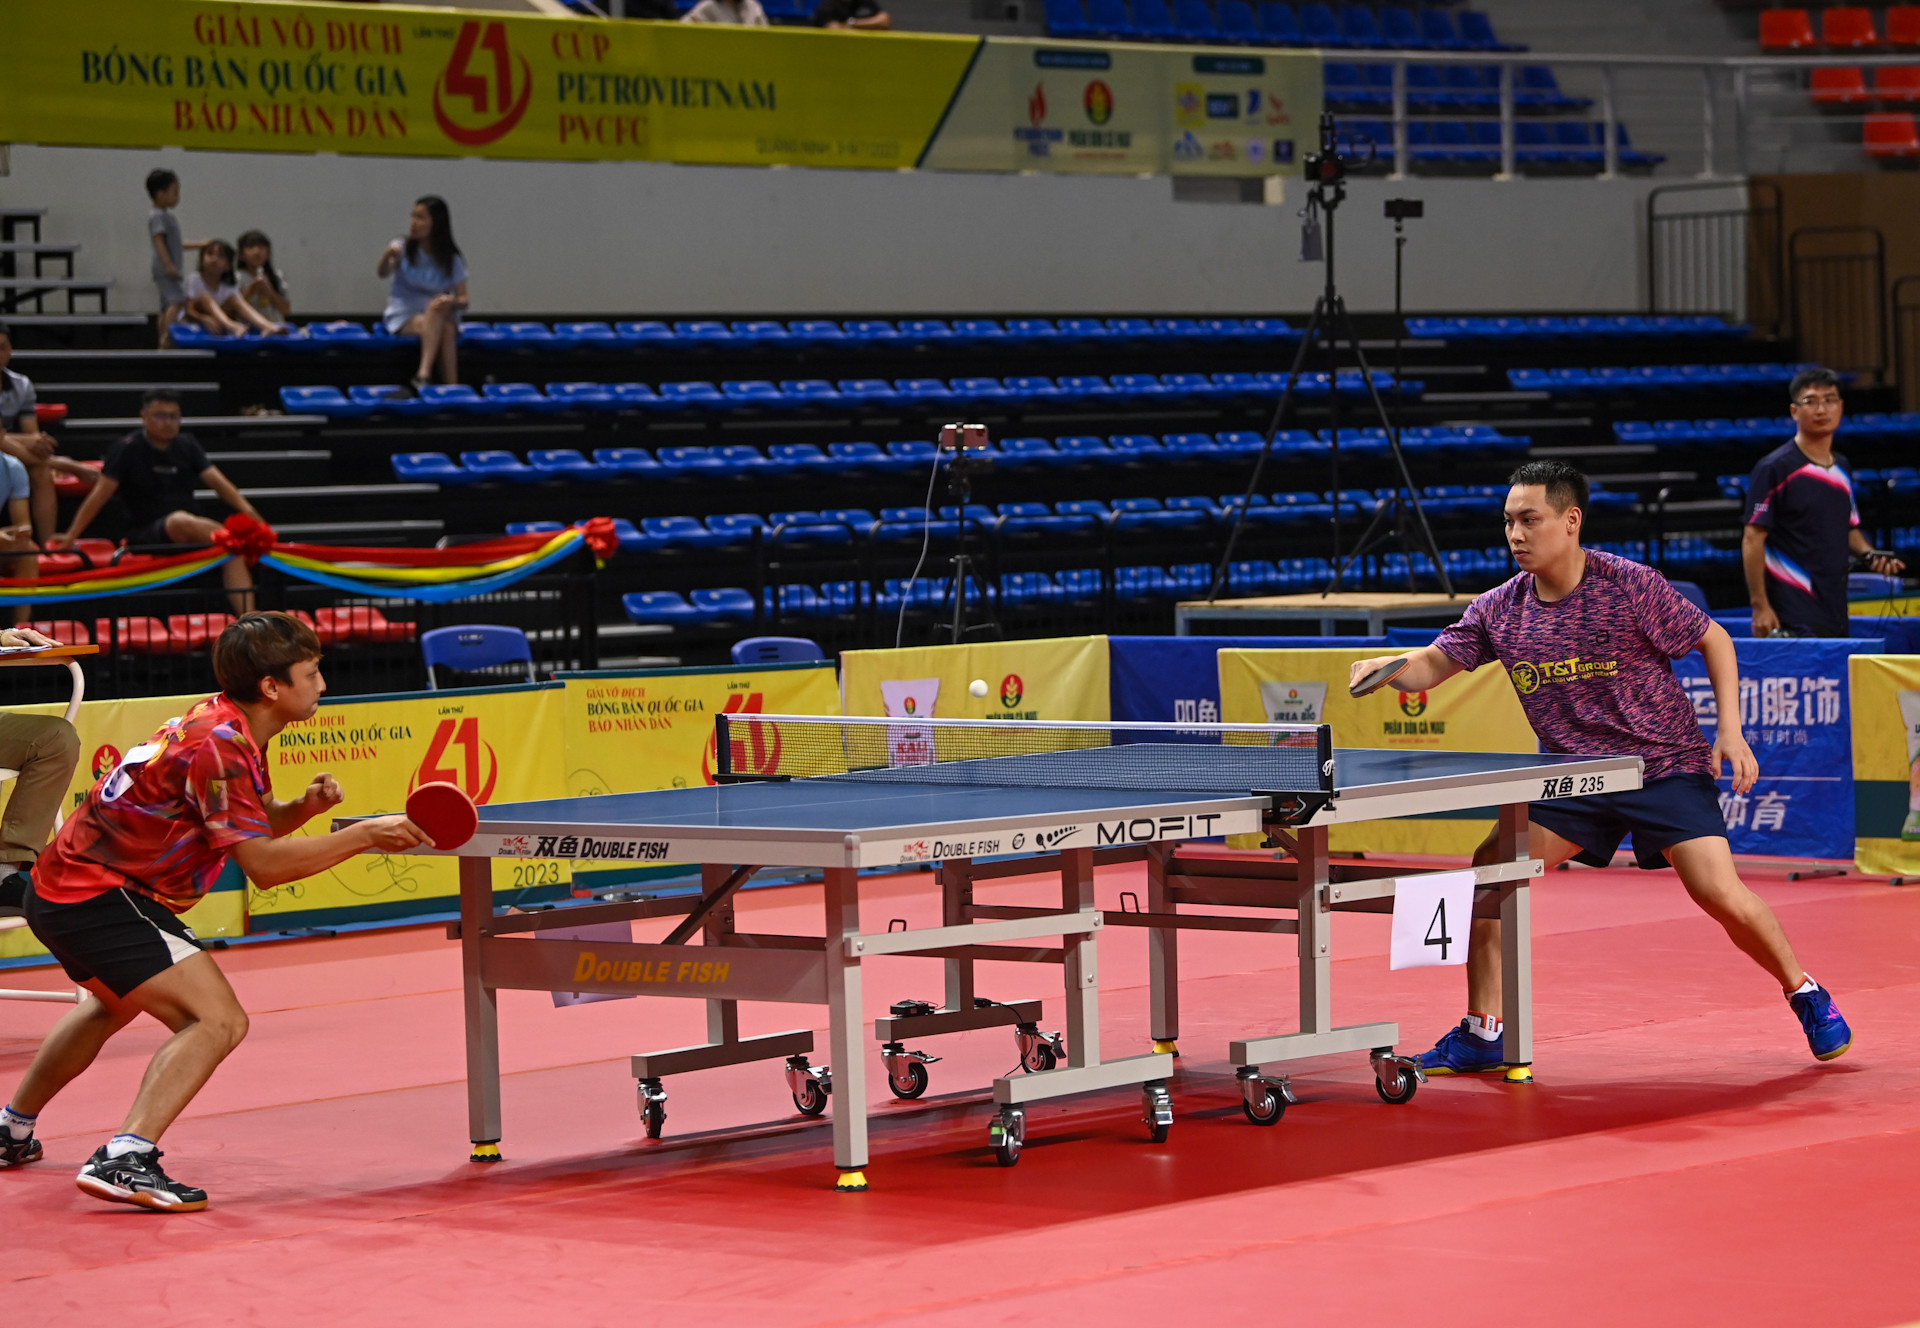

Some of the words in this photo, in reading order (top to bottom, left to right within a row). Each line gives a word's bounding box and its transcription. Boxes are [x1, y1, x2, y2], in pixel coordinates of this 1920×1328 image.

[82, 44, 173, 86] BÓNG
[185, 49, 248, 89] BÀN
[259, 52, 345, 97] QUỐC
[355, 65, 408, 98] GIA
[558, 72, 776, 112] PETROVIETNAM
[174, 93, 238, 133] BÁO
[248, 97, 336, 136] NHÂN
[347, 100, 408, 138] DÂN
[559, 113, 648, 146] PVCFC
[1538, 657, 1580, 678] T&T
[1578, 660, 1617, 673] GROUP
[647, 696, 682, 714] QUỐC
[684, 698, 704, 712] GIA
[280, 730, 316, 747] BÓNG
[320, 727, 346, 745] BÀN
[350, 723, 387, 745] QUỐC
[389, 726, 412, 740] GIA
[616, 715, 647, 732] NHÂN
[280, 748, 306, 765] BÁO
[310, 746, 346, 763] NHÂN
[351, 743, 377, 760] DÂN
[1541, 775, 1574, 799] 双鱼
[1580, 776, 1604, 794] 235
[1097, 813, 1221, 845] MOFIT
[534, 835, 579, 858] 双鱼
[580, 837, 637, 859] DOUBLE
[637, 841, 670, 860] FISH
[932, 841, 974, 860] DOUBLE
[976, 840, 1000, 855] FISH
[513, 862, 560, 888] 2023
[1424, 897, 1453, 961] 4
[573, 952, 670, 983] DOUBLE
[677, 961, 730, 984] FISH
